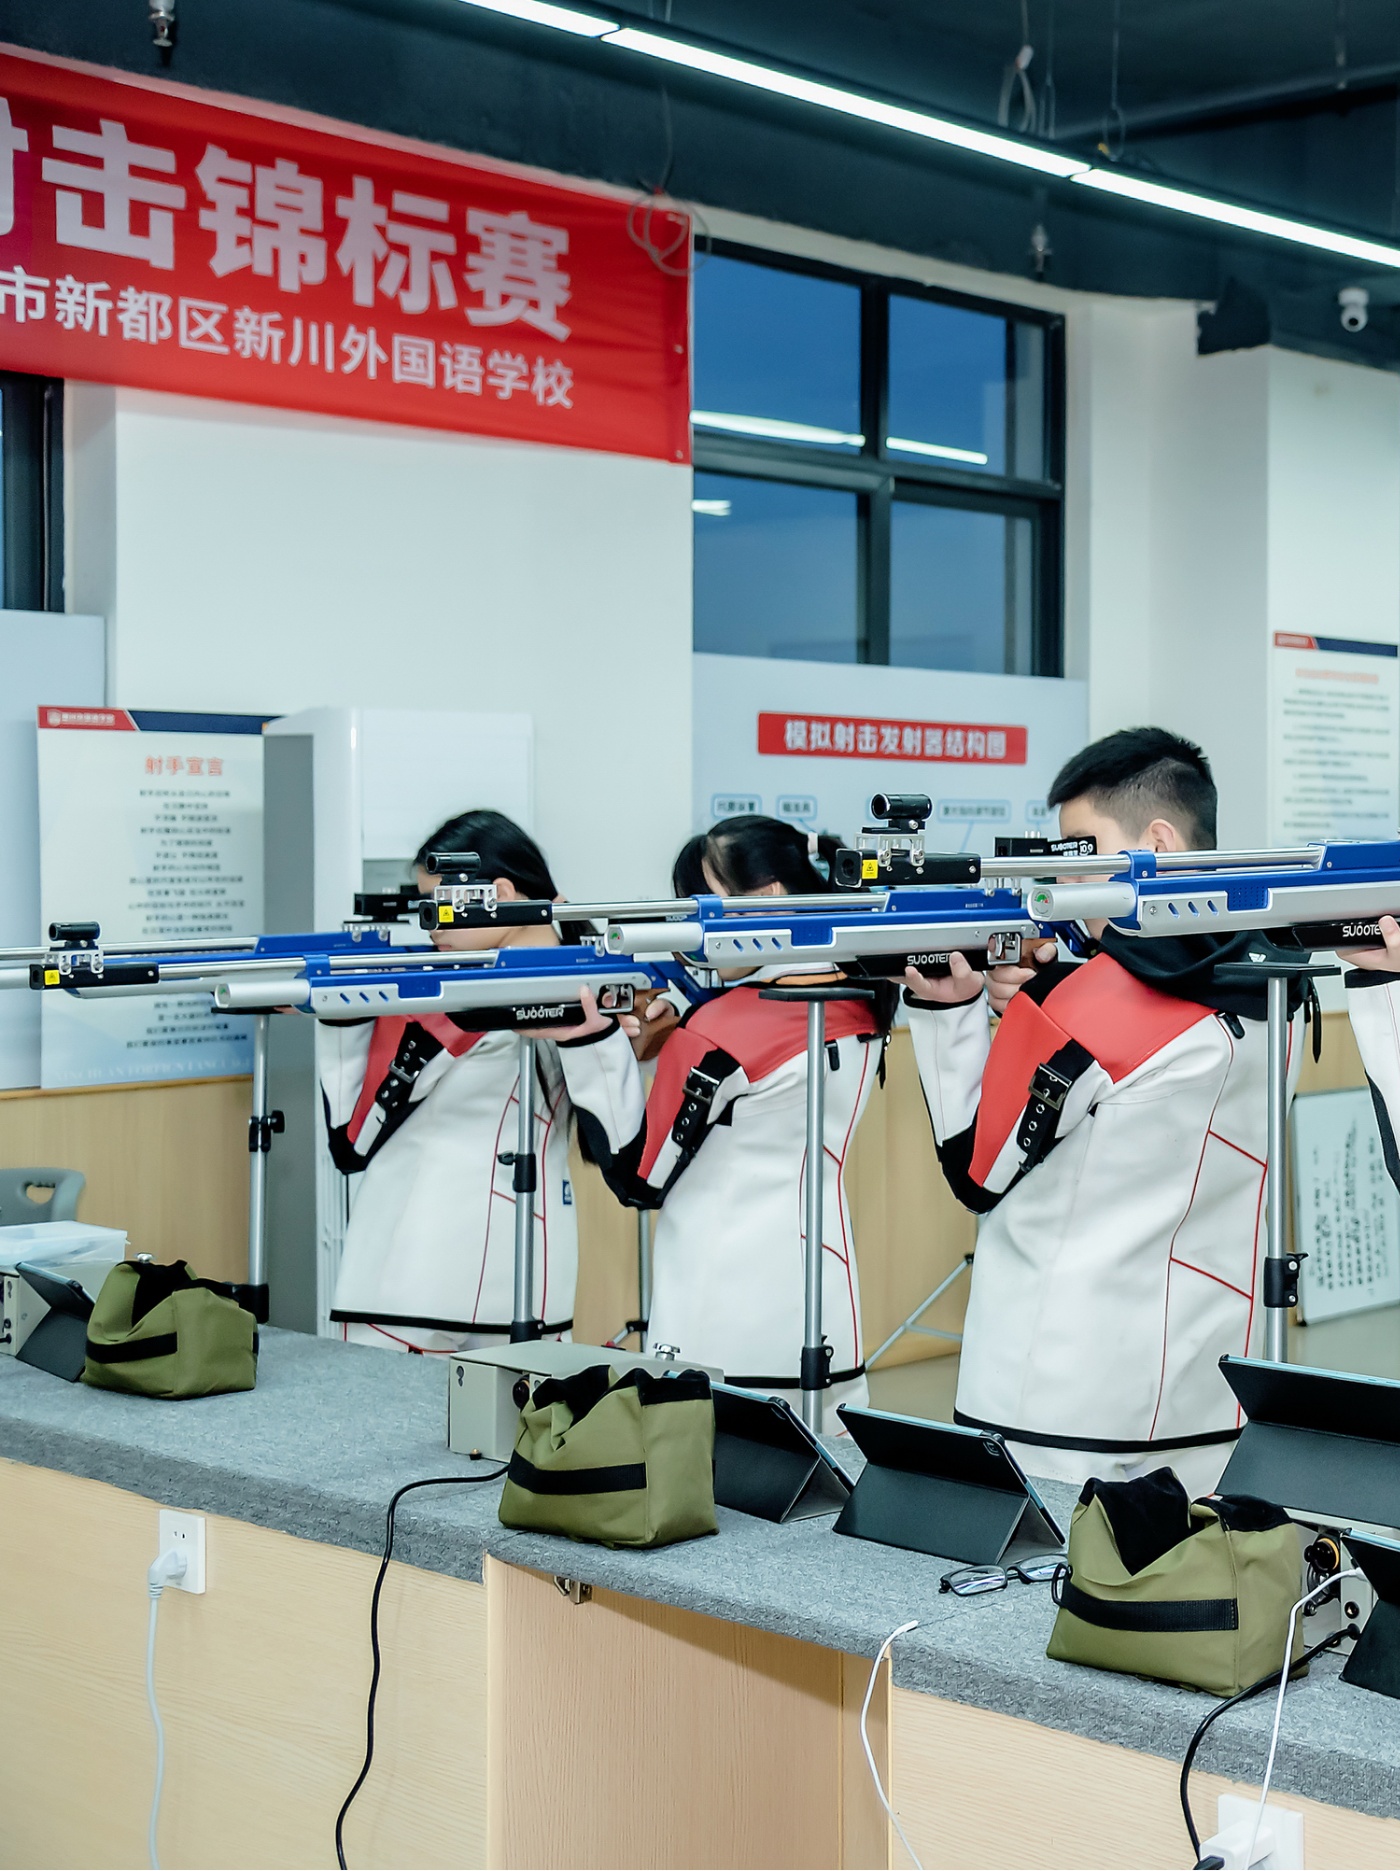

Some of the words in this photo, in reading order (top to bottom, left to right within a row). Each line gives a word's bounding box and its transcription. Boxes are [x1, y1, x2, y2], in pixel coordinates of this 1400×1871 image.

[0, 95, 572, 343] 击锦标赛
[0, 264, 574, 409] 市新都区新川外国语学校
[785, 719, 1007, 759] 模拟射击发射器结构图
[145, 756, 223, 776] 射手宣言
[1342, 924, 1382, 937] SUOOTE
